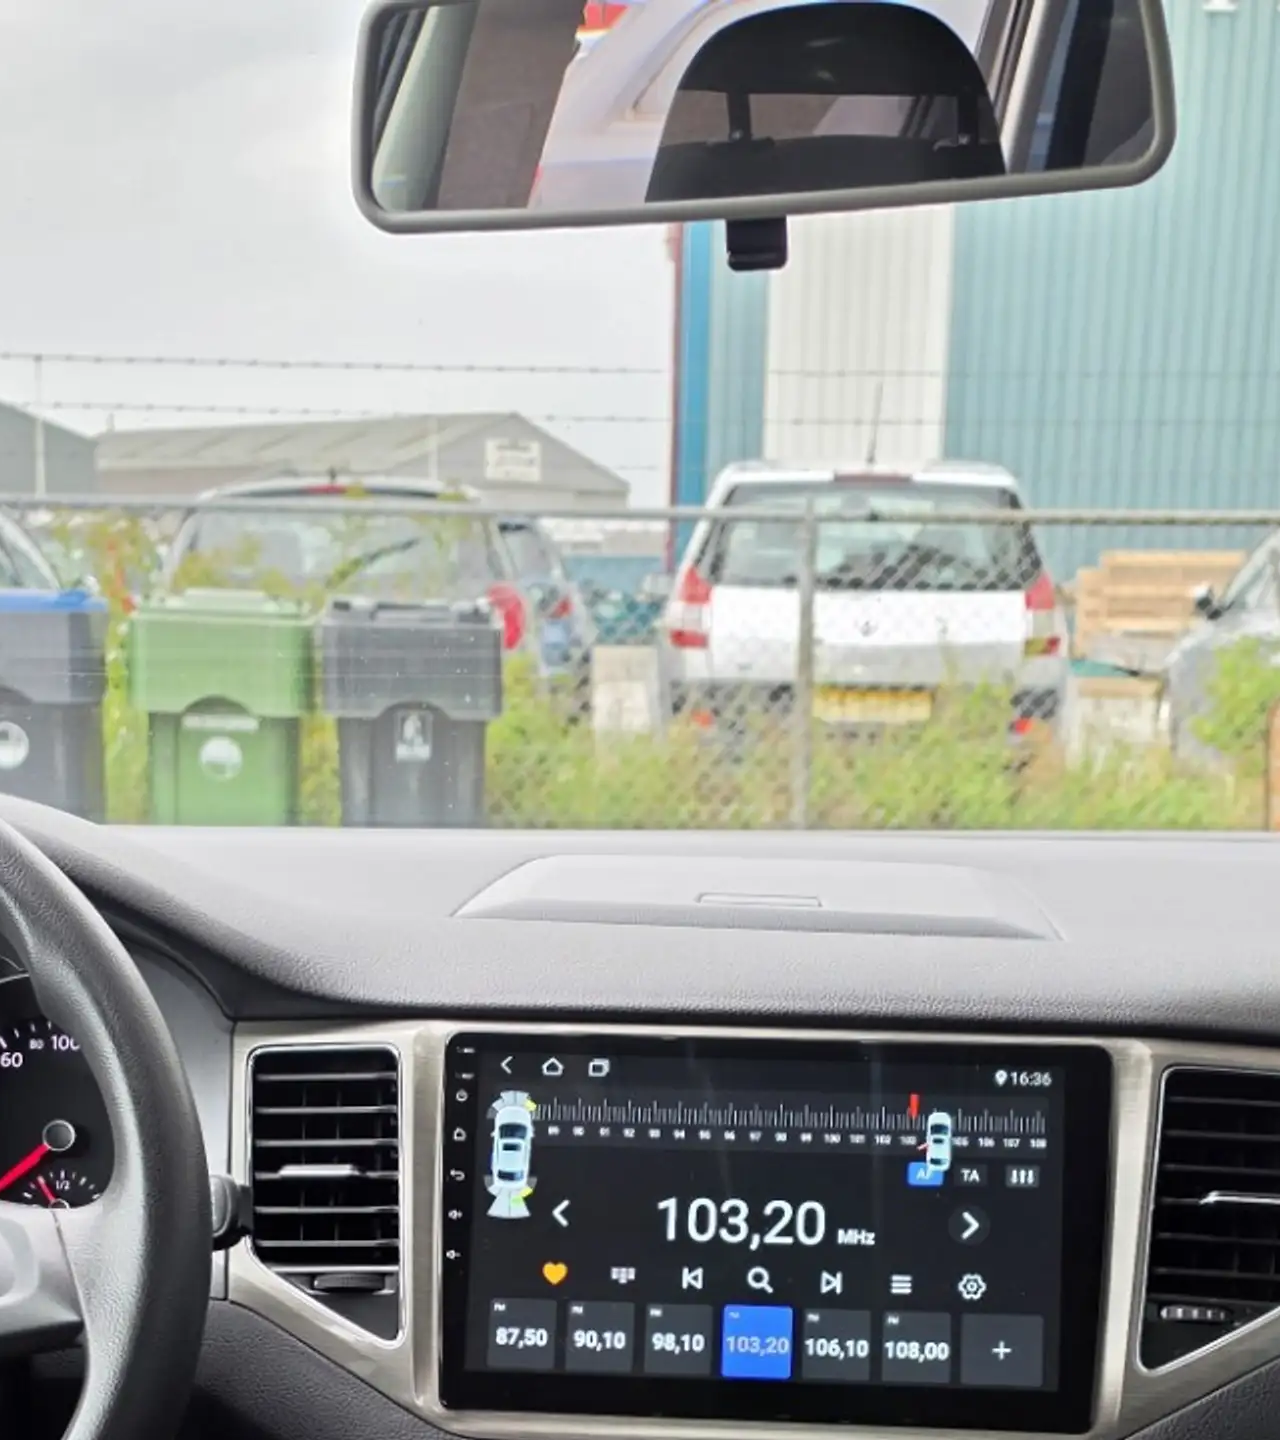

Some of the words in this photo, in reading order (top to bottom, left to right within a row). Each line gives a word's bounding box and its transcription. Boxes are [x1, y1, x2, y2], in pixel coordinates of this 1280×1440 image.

[0, 1052, 24, 1068] 60
[1010, 1072, 1052, 1086] 16:36
[961, 1169, 980, 1182] TA
[657, 1196, 826, 1251] 103,20
[837, 1229, 876, 1246] MHz
[496, 1327, 548, 1349] 87,50
[574, 1330, 626, 1352] 90,10
[652, 1333, 705, 1355] 98,10
[726, 1335, 790, 1357] 103,20
[805, 1338, 869, 1360] 106,10
[885, 1341, 950, 1363] 108,00
